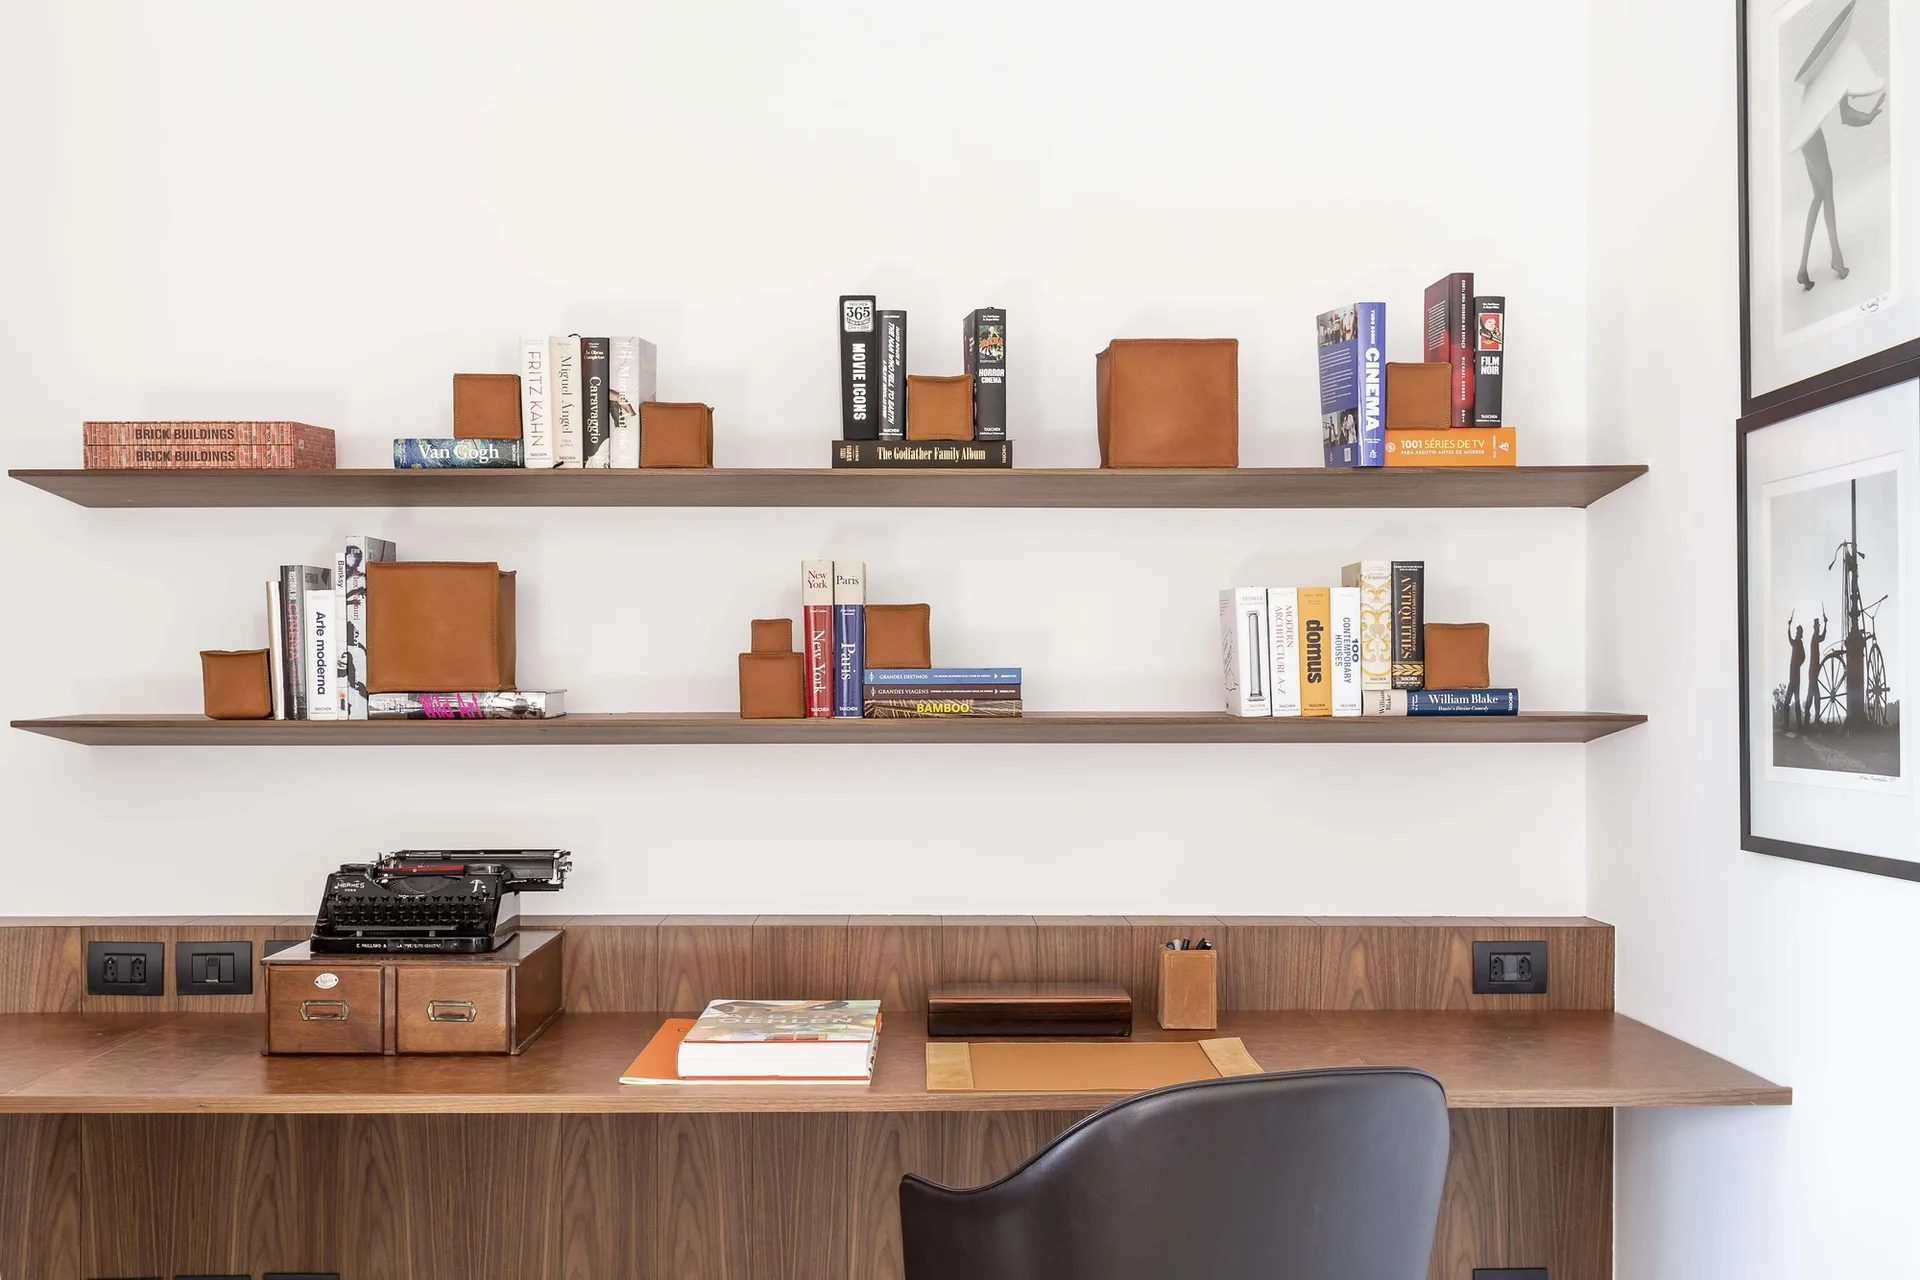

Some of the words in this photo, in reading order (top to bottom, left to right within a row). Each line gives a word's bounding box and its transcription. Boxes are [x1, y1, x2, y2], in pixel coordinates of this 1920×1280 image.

[846, 306, 870, 320] 365
[528, 352, 543, 396] FRITZ
[558, 356, 572, 396] Miguel
[852, 343, 866, 380] MOVIE
[1481, 356, 1500, 366] FILM
[1481, 366, 1499, 375] NOIR
[852, 383, 867, 421] ICONS
[888, 388, 895, 399] TO
[1365, 348, 1380, 432] CINEMA
[530, 400, 544, 446] KAHN
[560, 400, 575, 434] Ángel
[587, 376, 601, 444] Caravaggio
[135, 428, 171, 440] BRICK
[174, 428, 234, 440] BUILDINGS
[1401, 440, 1422, 448] 1001
[1424, 438, 1456, 448] SÉRIES
[1458, 440, 1470, 448] DE
[1471, 440, 1485, 448] TV
[136, 451, 171, 462] BRICK
[175, 451, 236, 462] BUILDINGS
[418, 444, 450, 459] Van
[453, 444, 500, 464] Gogh
[877, 447, 892, 460] The
[894, 447, 932, 460] Godfather
[934, 447, 960, 463] Family
[960, 447, 986, 460] Album
[807, 580, 827, 589] York
[808, 570, 827, 579] New
[836, 575, 859, 585] Paris
[288, 603, 299, 661] CINEMA
[315, 611, 326, 636] Arte
[1285, 605, 1294, 648] MODERN
[1398, 576, 1411, 659] ANTIQUITIES
[812, 630, 825, 660] New
[1275, 605, 1285, 674] ARCHITECTURE
[1306, 620, 1324, 683] domus
[1343, 617, 1351, 684] CONTEMPORARY
[316, 640, 327, 695] moderna
[841, 642, 856, 680] Paris
[813, 663, 826, 695] York
[1278, 677, 1286, 694] A-Z
[418, 693, 455, 718] Wild
[457, 693, 483, 718] Art
[917, 704, 970, 713] BAMBOO
[1428, 694, 1470, 704] William
[1471, 694, 1498, 704] Blake
